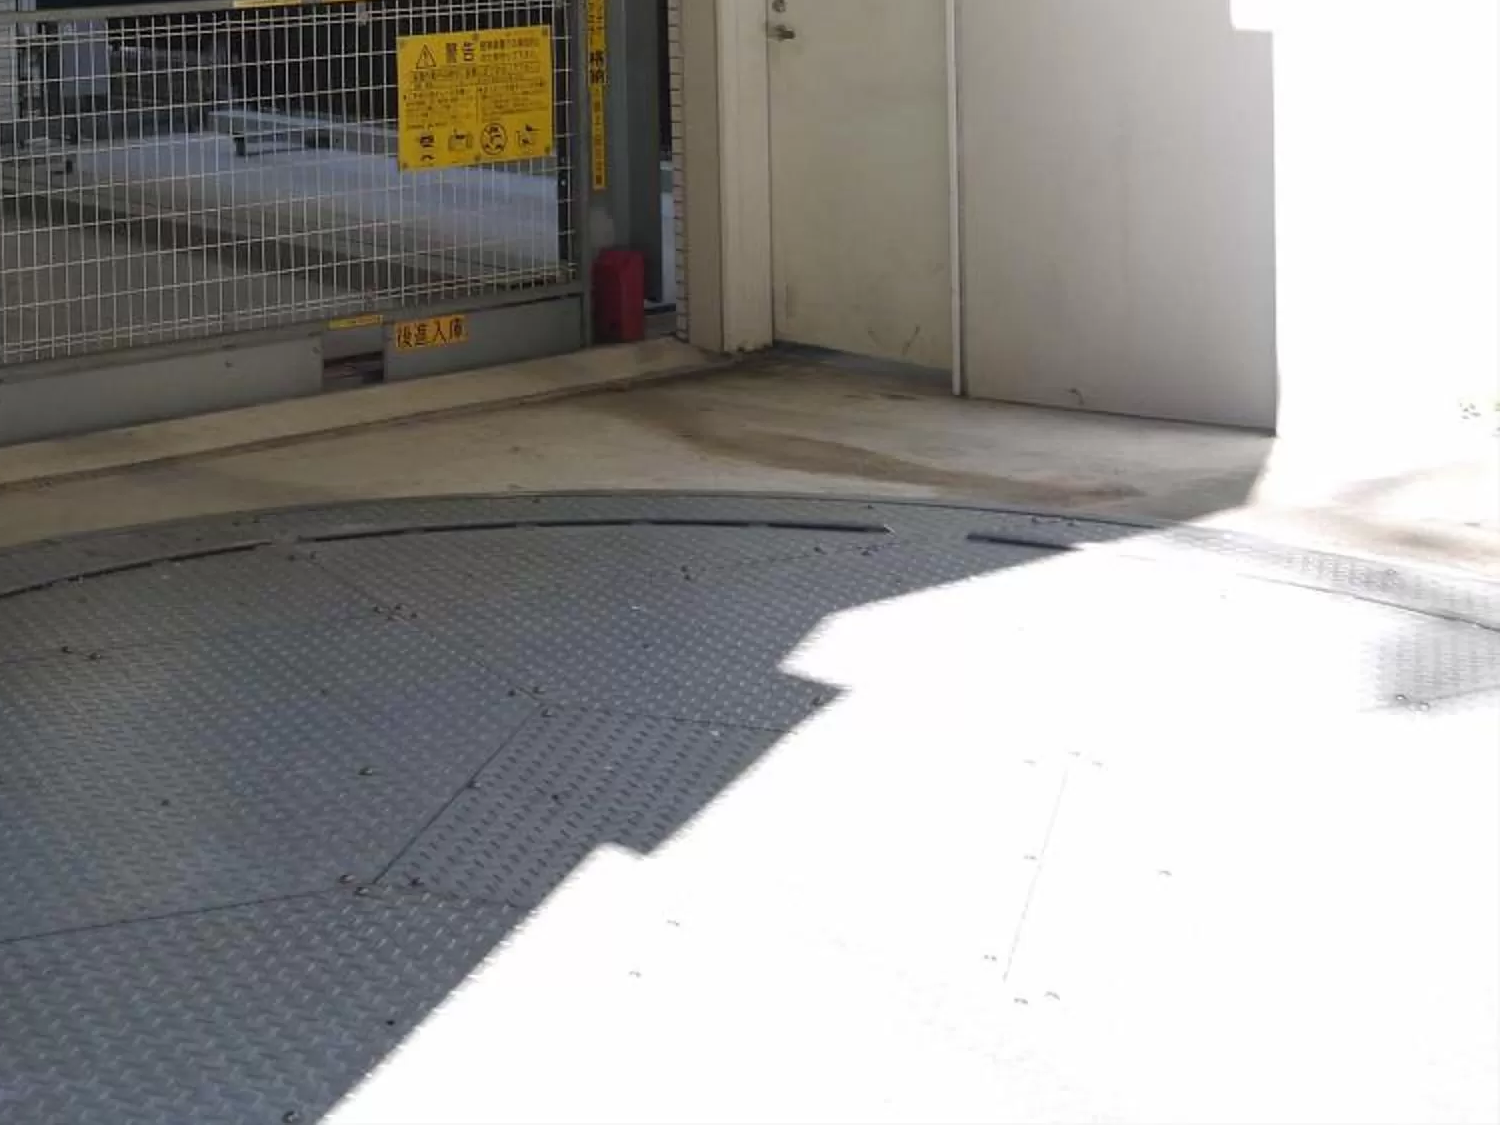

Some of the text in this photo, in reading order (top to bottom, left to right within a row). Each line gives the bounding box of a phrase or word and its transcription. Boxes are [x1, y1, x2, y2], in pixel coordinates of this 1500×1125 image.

[445, 41, 475, 64] 警告
[395, 316, 467, 349] 後進入庫
